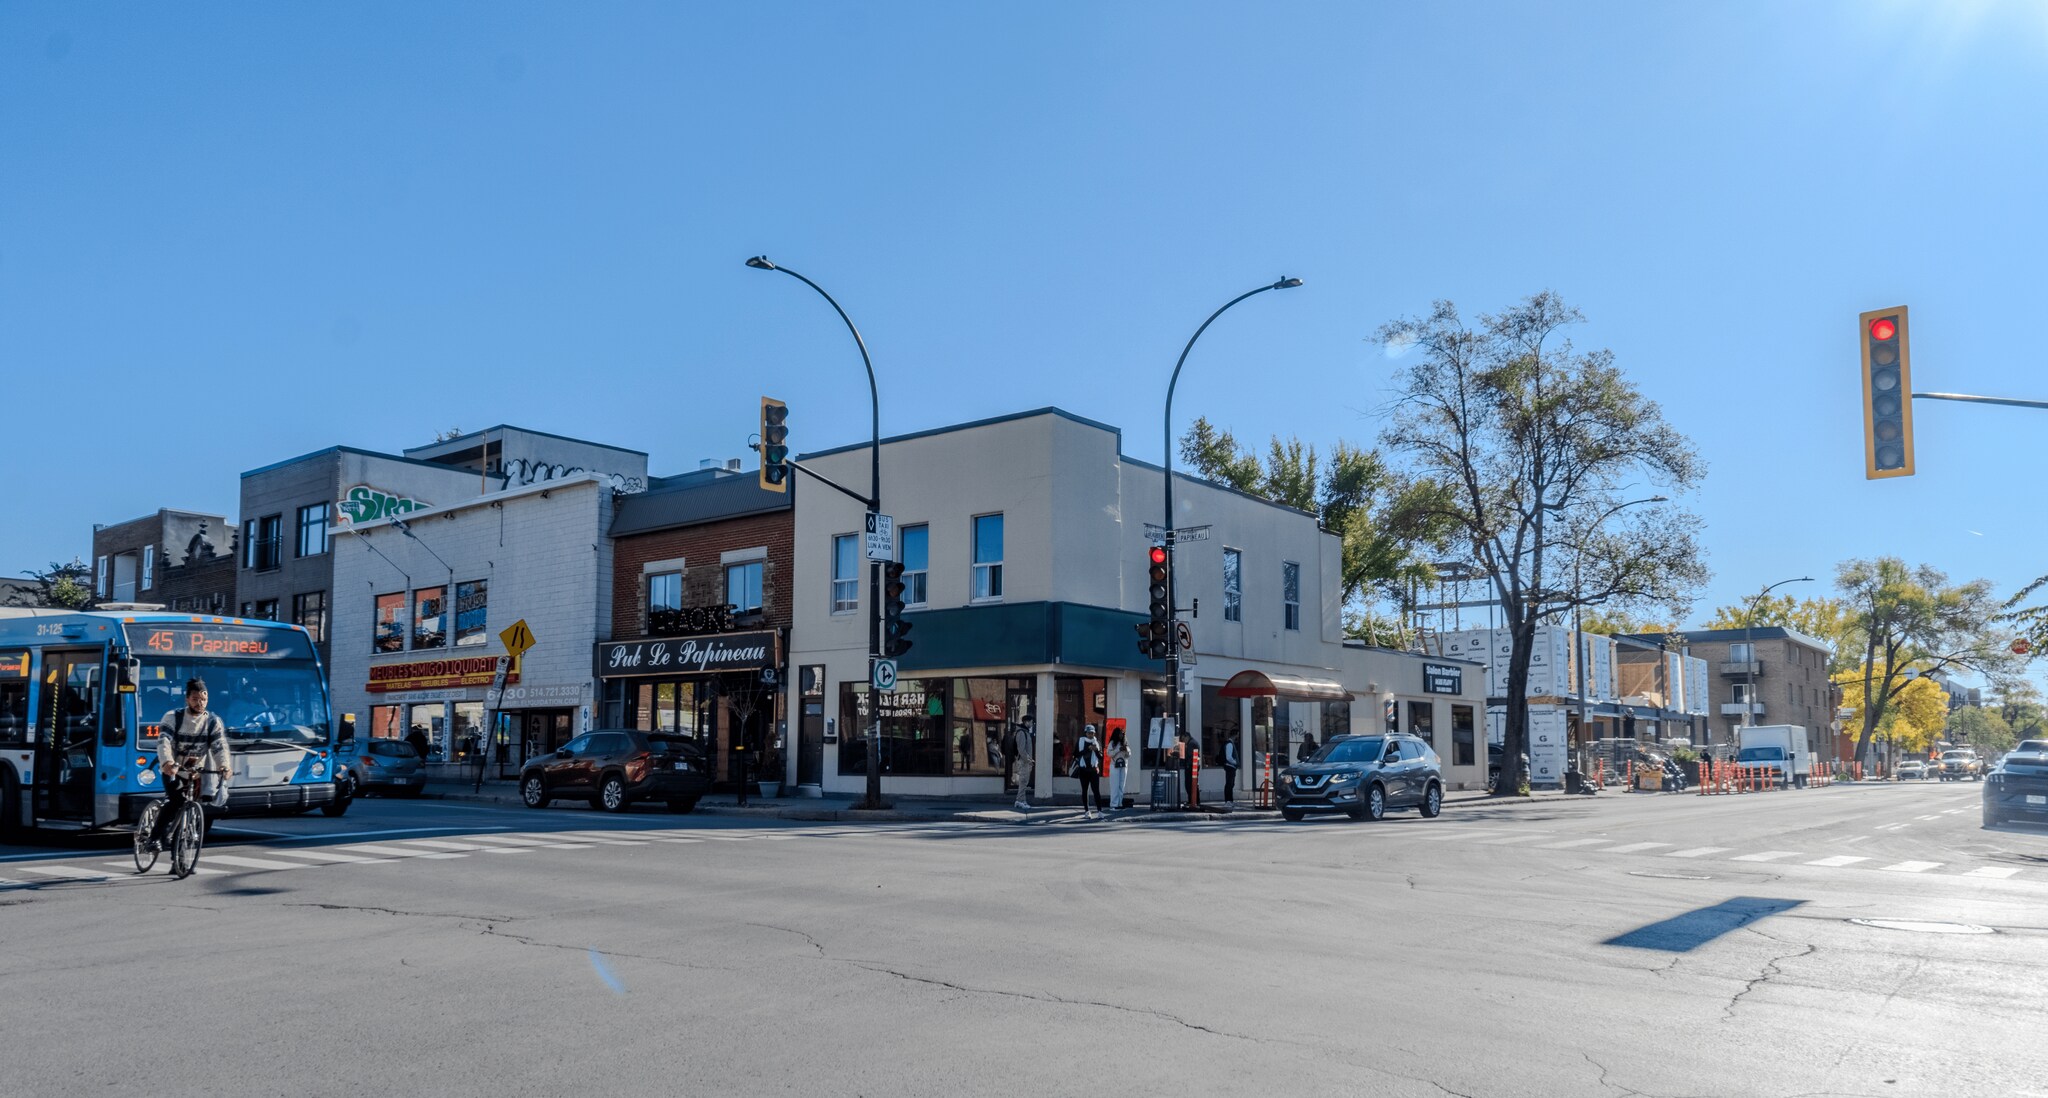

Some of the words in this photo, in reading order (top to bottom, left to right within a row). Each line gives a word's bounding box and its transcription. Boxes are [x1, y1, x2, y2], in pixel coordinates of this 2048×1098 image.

[37, 623, 63, 636] 31-125
[148, 632, 174, 650] 45
[191, 633, 268, 654] Papineau
[609, 645, 642, 668] Pub
[648, 642, 670, 666] Le
[678, 640, 765, 672] Papineau
[371, 664, 409, 680] MEUBLES
[411, 661, 444, 676] AMIGO
[446, 656, 497, 676] LIQUIDATI
[1426, 665, 1441, 675] Salon
[1442, 667, 1461, 677] Barbier
[386, 681, 411, 690] MATELAS
[420, 679, 449, 688] MEUBLES
[460, 676, 489, 685] ELECTRO
[530, 685, 579, 698] 514.721.3330
